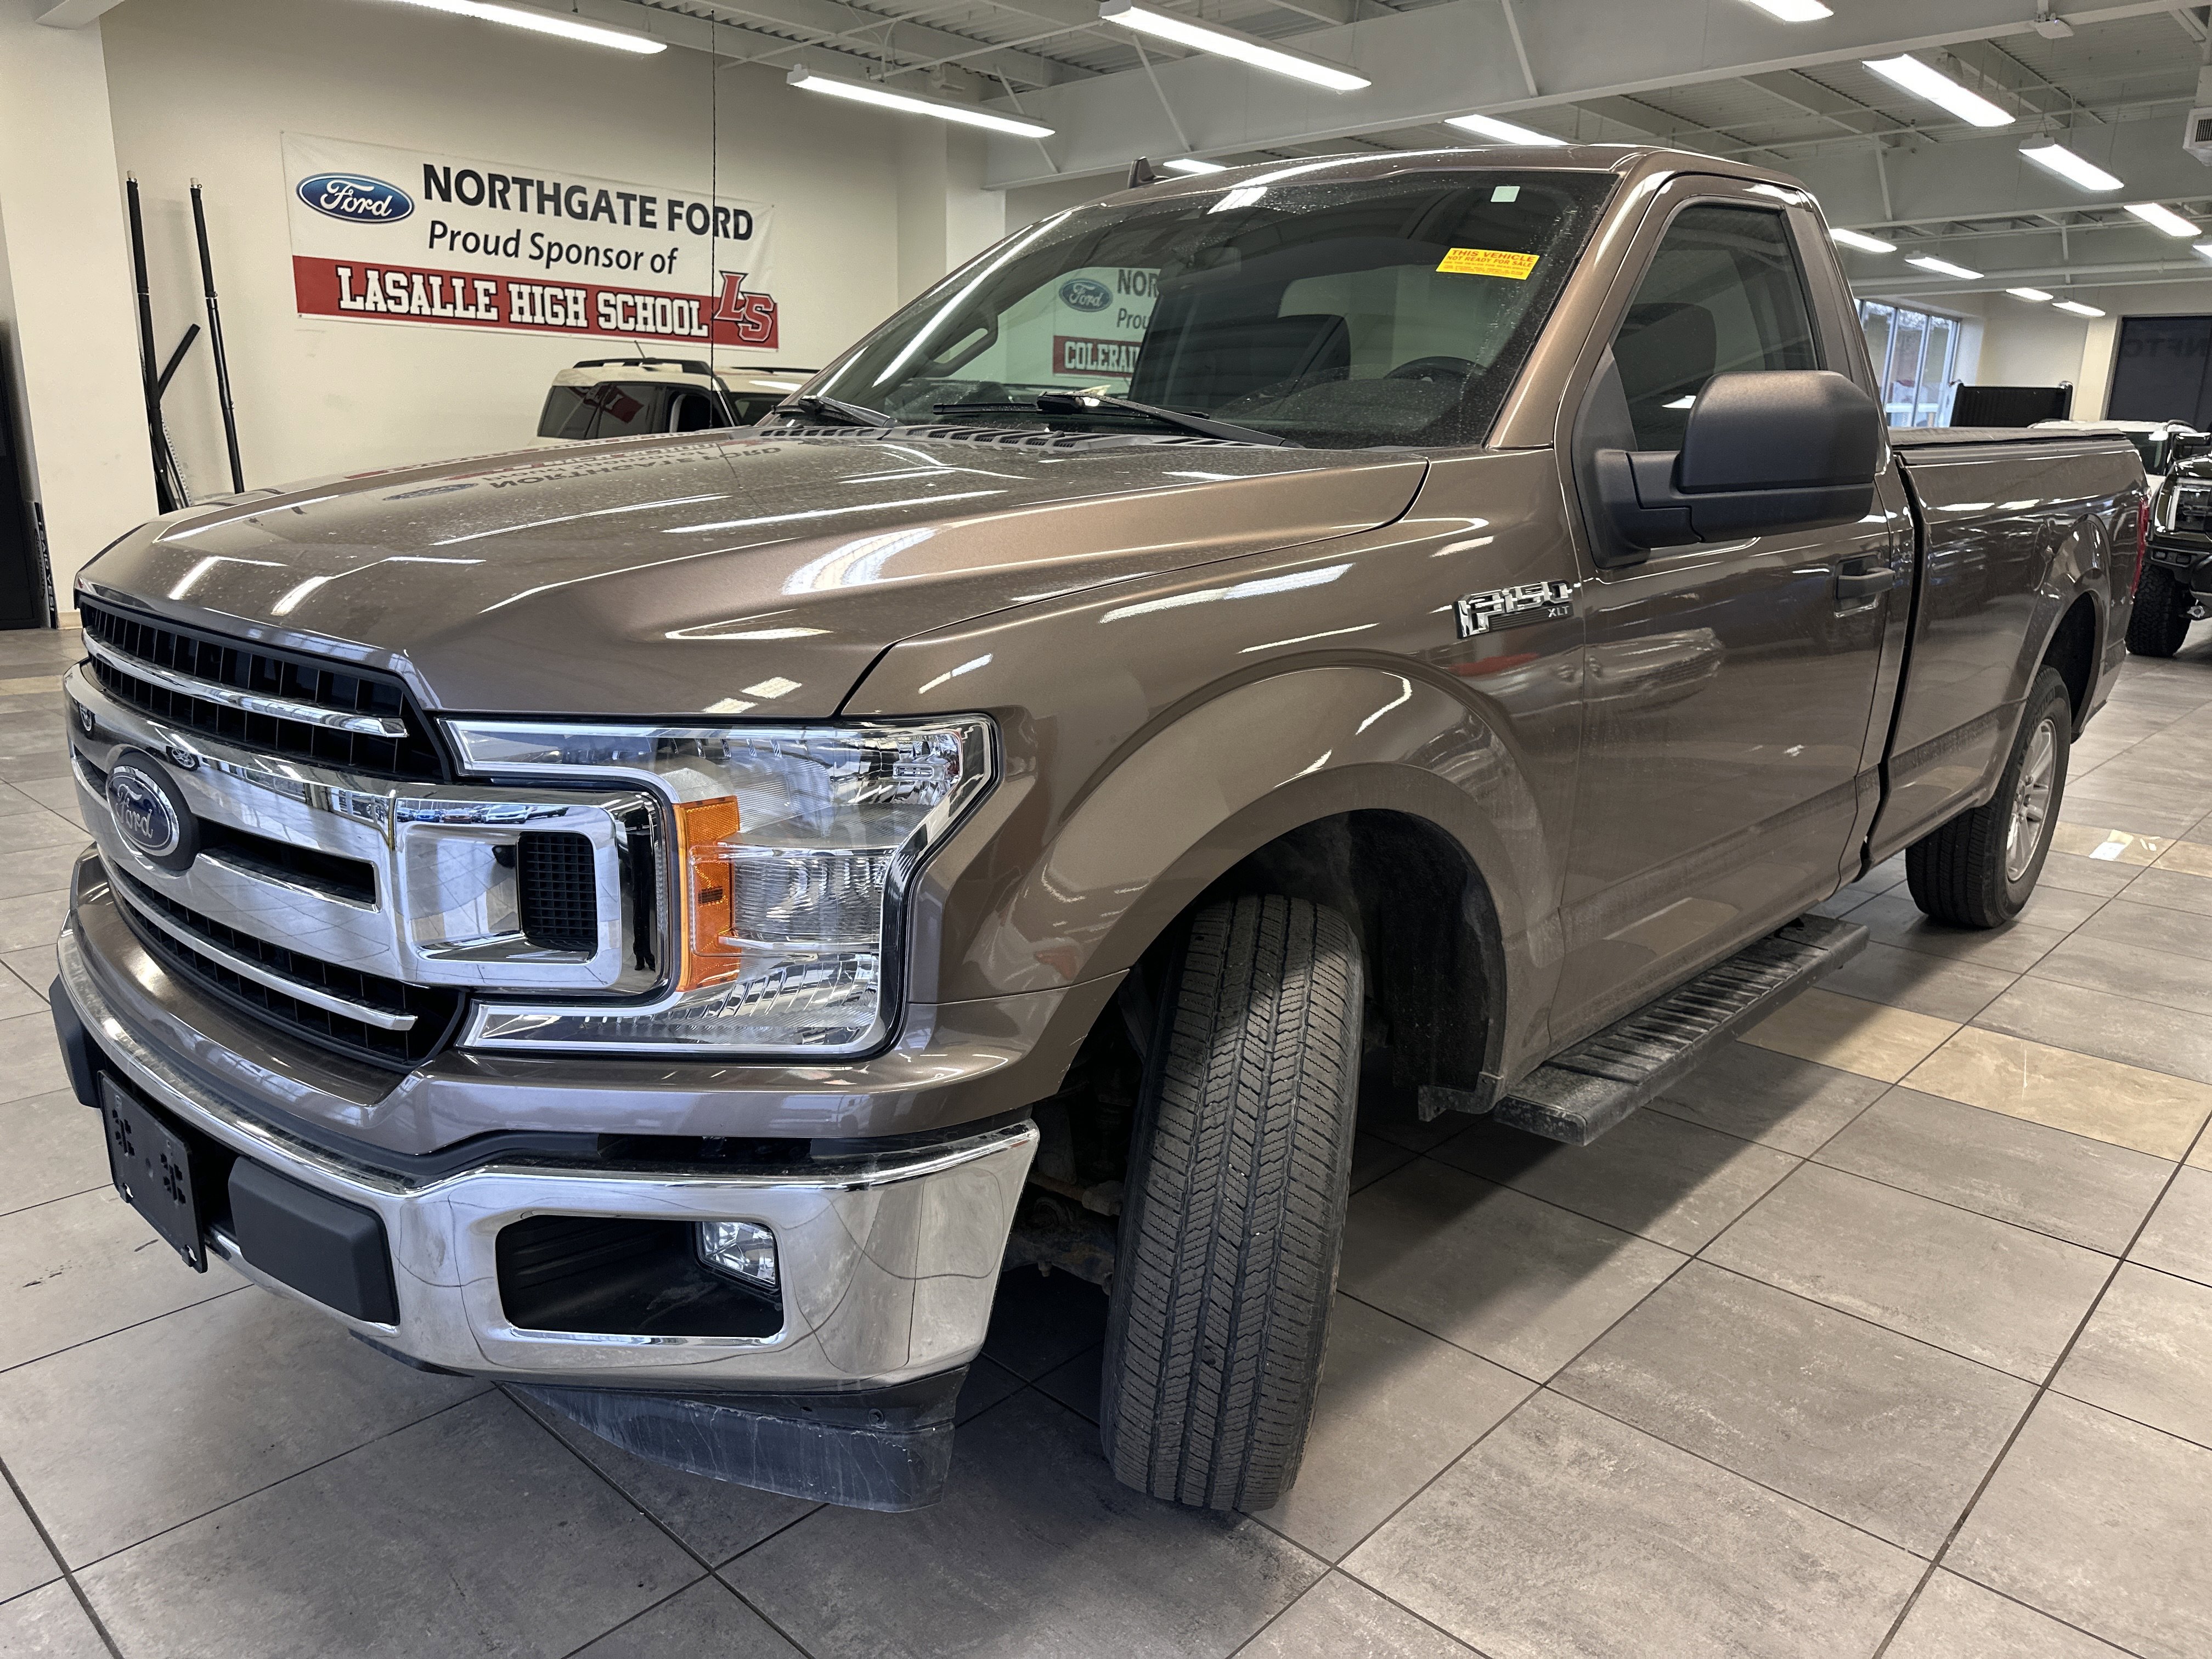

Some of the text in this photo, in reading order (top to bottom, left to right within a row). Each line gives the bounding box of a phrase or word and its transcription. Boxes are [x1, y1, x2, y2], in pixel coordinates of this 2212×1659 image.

[320, 179, 393, 217] Ford
[423, 163, 753, 241] NORTHGATE FORD
[428, 220, 679, 274] Proud Sponsor of
[1483, 252, 1536, 262] VEHICLE
[335, 264, 709, 337] LASALLE HIGH SCHOOL
[714, 270, 777, 342] LS
[1069, 280, 1104, 307] Ford
[1547, 605, 1570, 618] XLT
[115, 783, 154, 839] Ford
